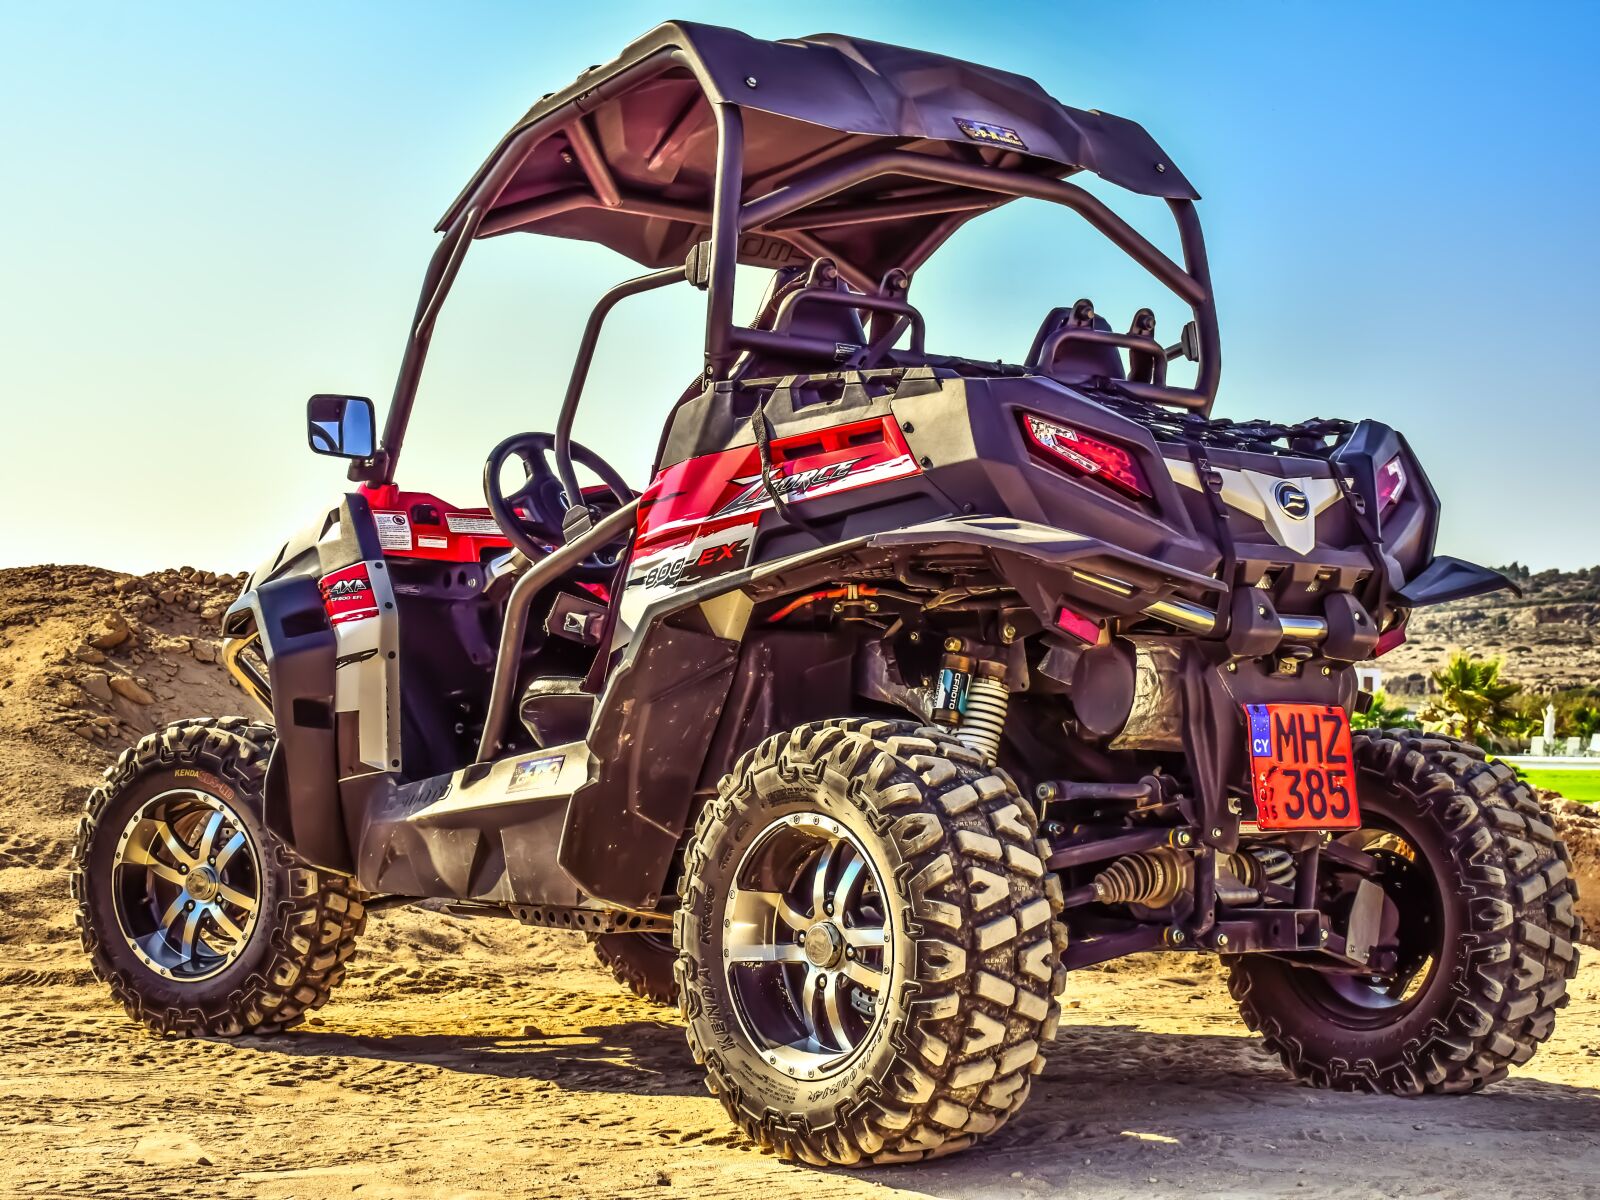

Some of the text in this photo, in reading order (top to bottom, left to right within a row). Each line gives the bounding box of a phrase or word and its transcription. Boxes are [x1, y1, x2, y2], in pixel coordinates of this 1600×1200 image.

[948, 672, 961, 710] CFMOTO
[1253, 739, 1269, 753] CY
[1275, 712, 1347, 764] MHZ
[174, 769, 199, 778] KENDA
[1282, 769, 1350, 819] 385
[697, 966, 737, 1052] KENDA
